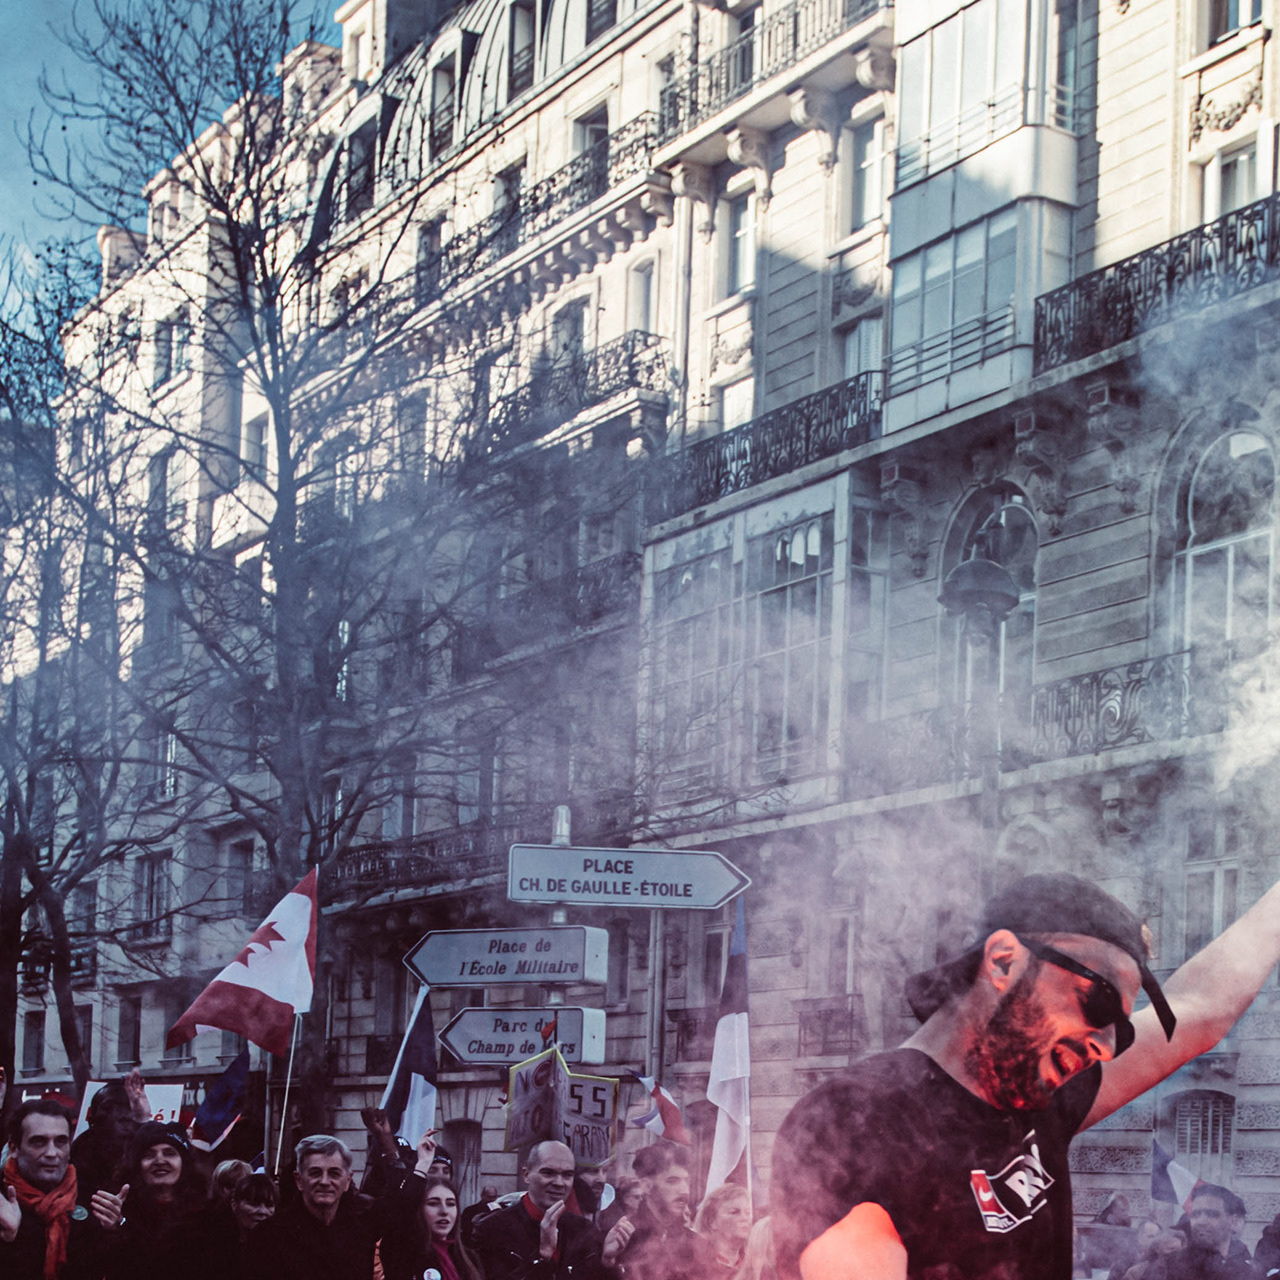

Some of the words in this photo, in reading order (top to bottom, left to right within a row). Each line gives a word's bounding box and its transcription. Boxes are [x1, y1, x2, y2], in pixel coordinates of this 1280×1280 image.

[582, 858, 634, 875] PLACE
[519, 877, 543, 892] CH.
[546, 878, 567, 893] DE
[488, 939, 527, 954] Place
[535, 938, 551, 952] de
[459, 960, 507, 976] l'École
[514, 960, 579, 975] Militaire
[493, 1018, 528, 1033] Parc
[467, 1040, 515, 1057] Champ
[520, 1040, 535, 1054] de
[540, 1041, 576, 1054] Mrs
